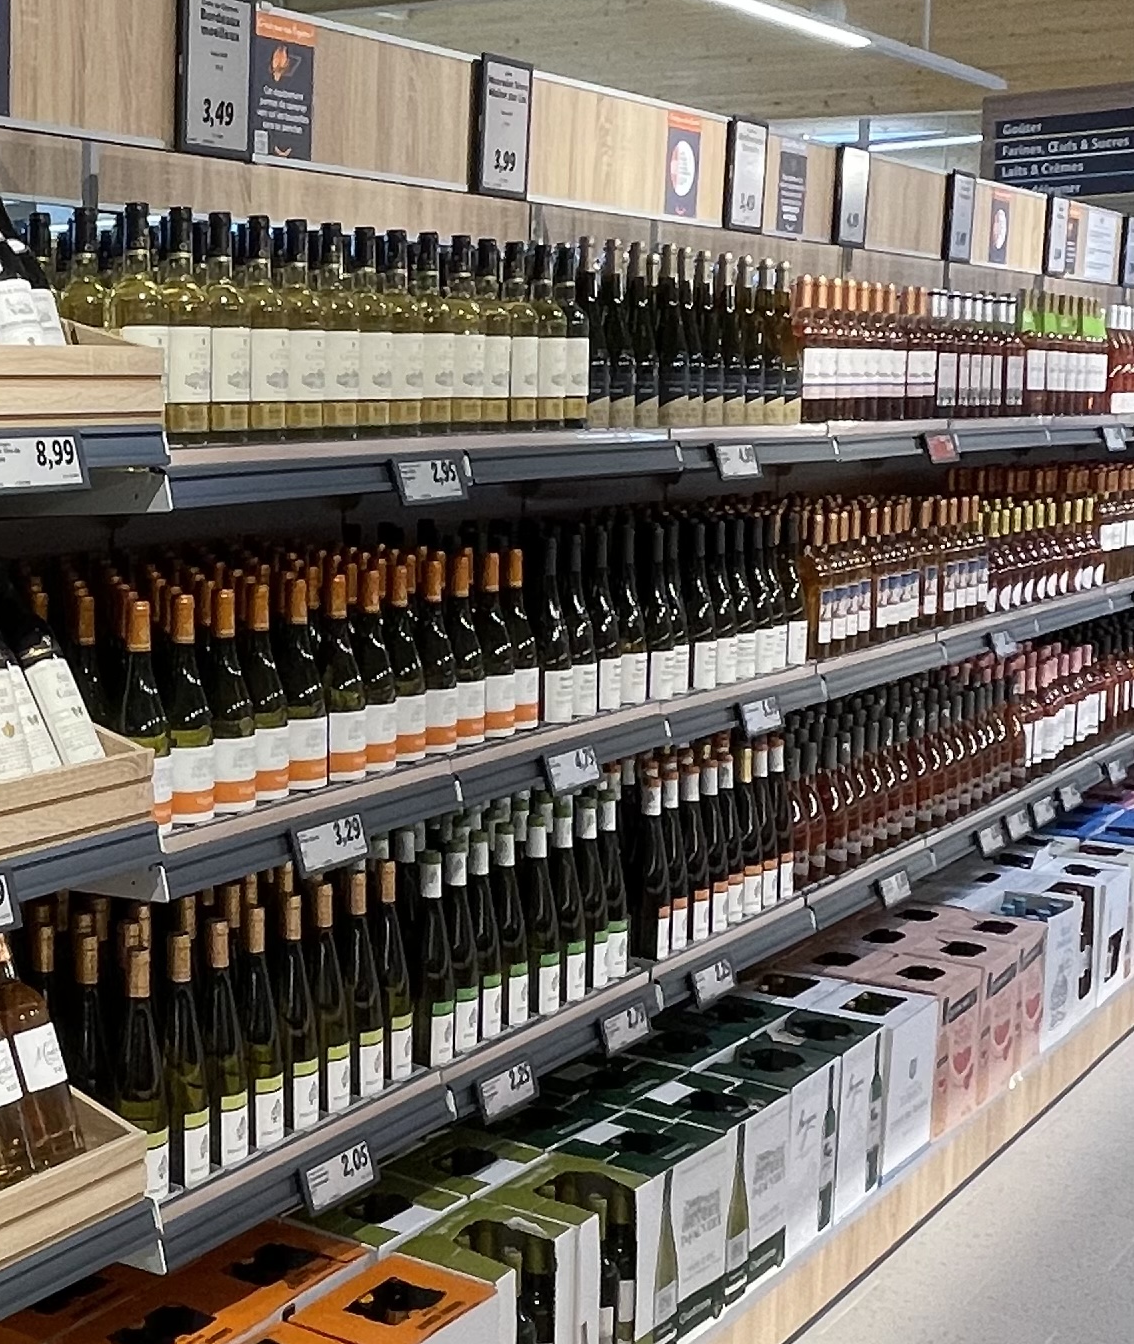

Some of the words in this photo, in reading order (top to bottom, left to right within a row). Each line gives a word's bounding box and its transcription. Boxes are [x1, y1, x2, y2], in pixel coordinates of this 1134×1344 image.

[202, 98, 234, 127] 3,49
[1080, 139, 1088, 150] &
[1091, 136, 1130, 149] Sucres
[1001, 166, 1028, 178] Laits
[36, 439, 74, 470] 8,99
[341, 1144, 367, 1177] 2,05
